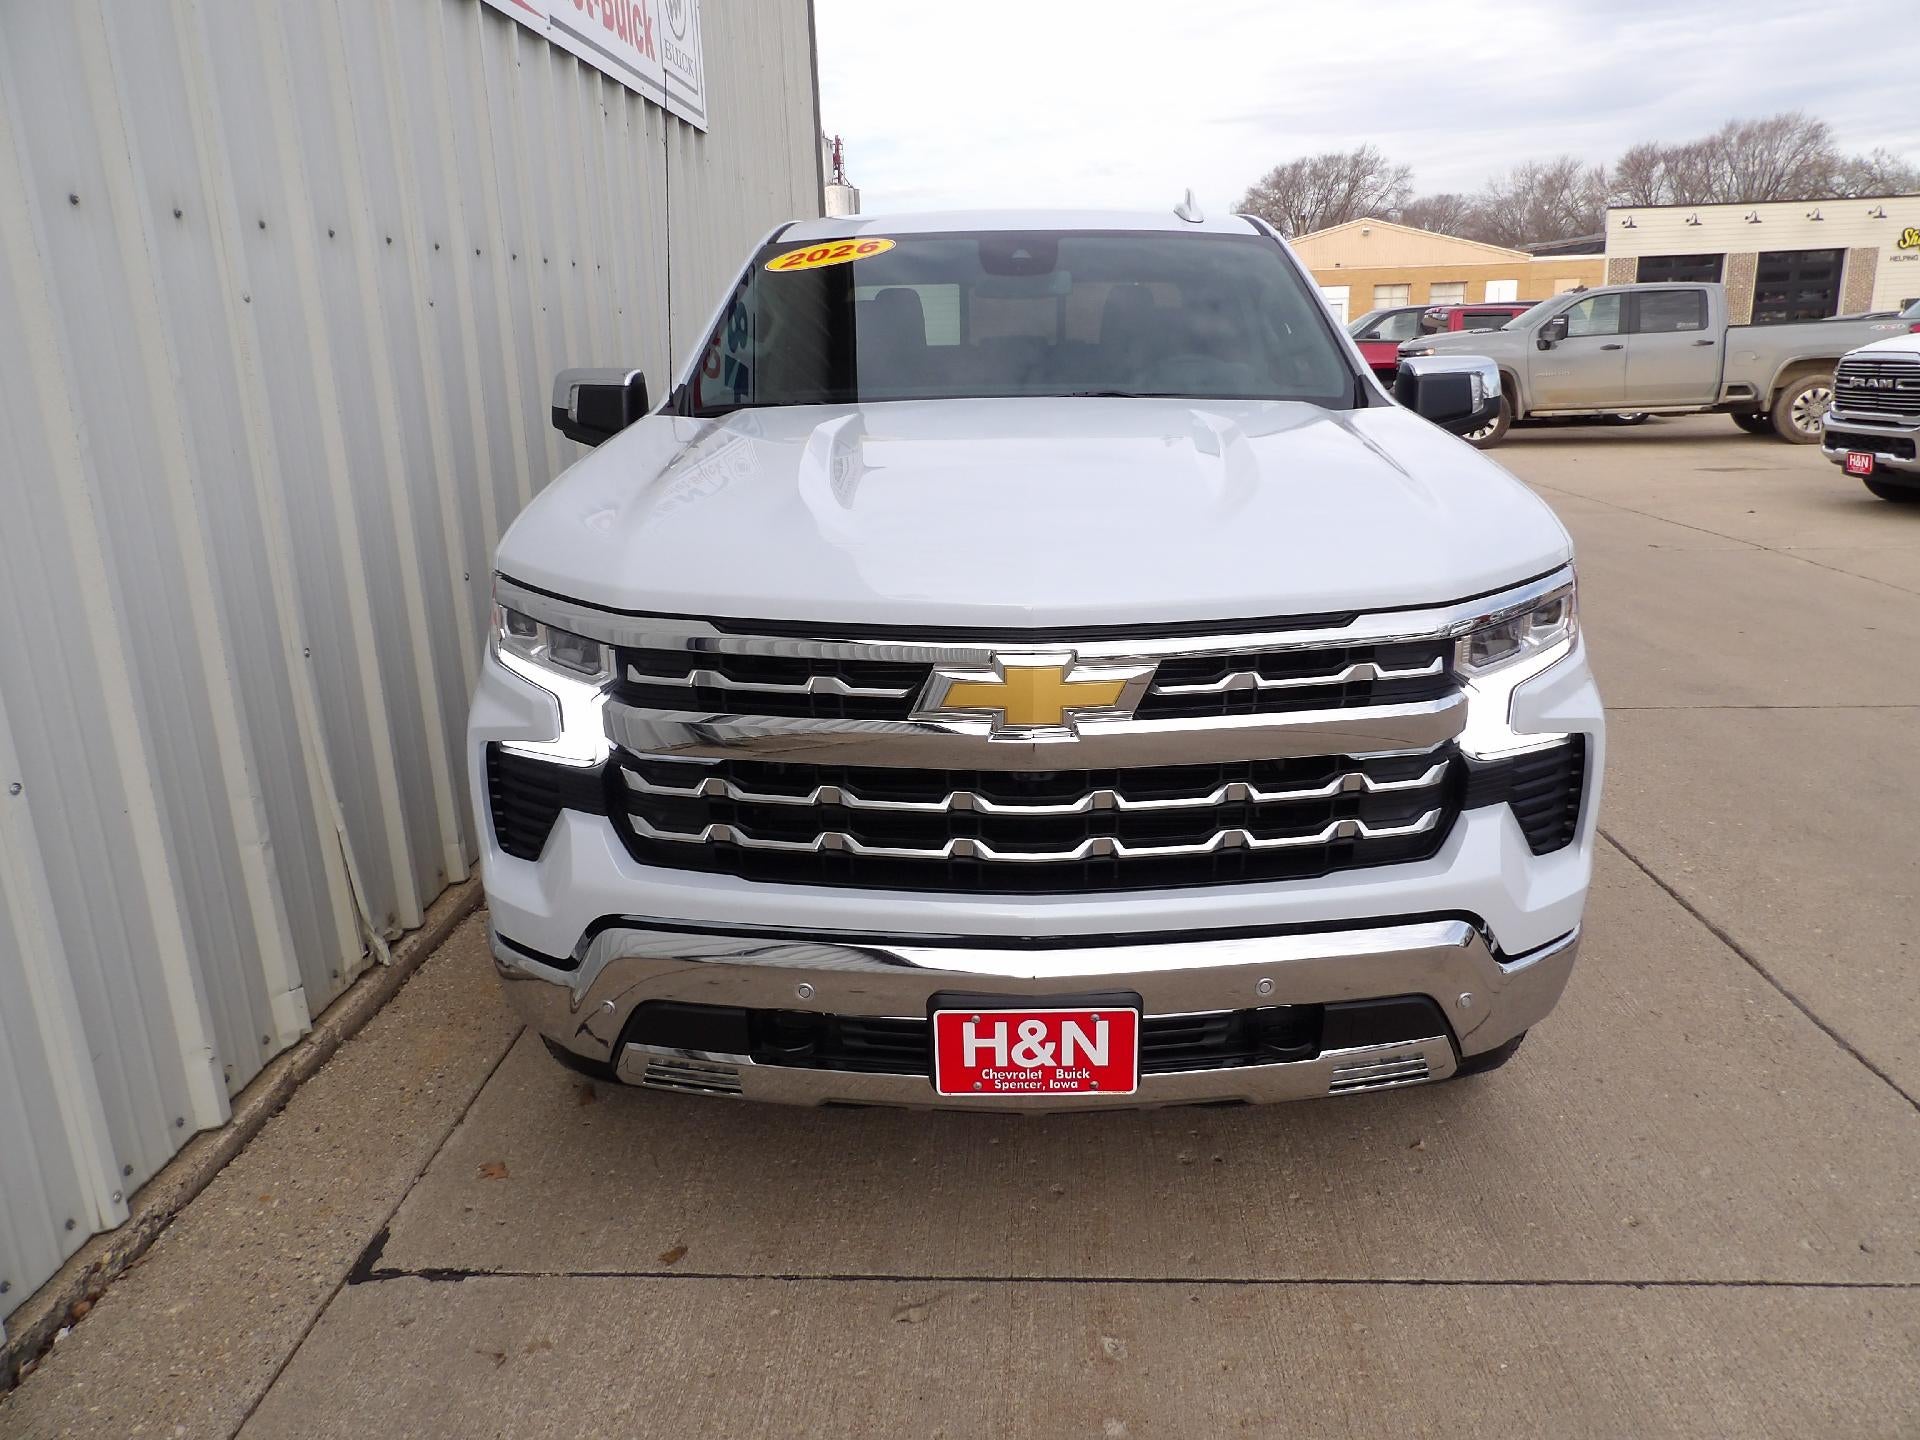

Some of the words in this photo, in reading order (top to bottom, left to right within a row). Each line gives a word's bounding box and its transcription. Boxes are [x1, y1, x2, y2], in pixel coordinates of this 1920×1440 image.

[664, 39, 695, 78] BUICK
[780, 241, 880, 269] 2026
[1849, 376, 1894, 389] RAM
[1849, 454, 1869, 468] H&N
[962, 1019, 1109, 1068] H&N
[981, 1068, 1043, 1080] Chevrolet
[1056, 1068, 1090, 1079] Buick
[994, 1079, 1046, 1091] Spencer,
[1049, 1079, 1078, 1089] Iowa
